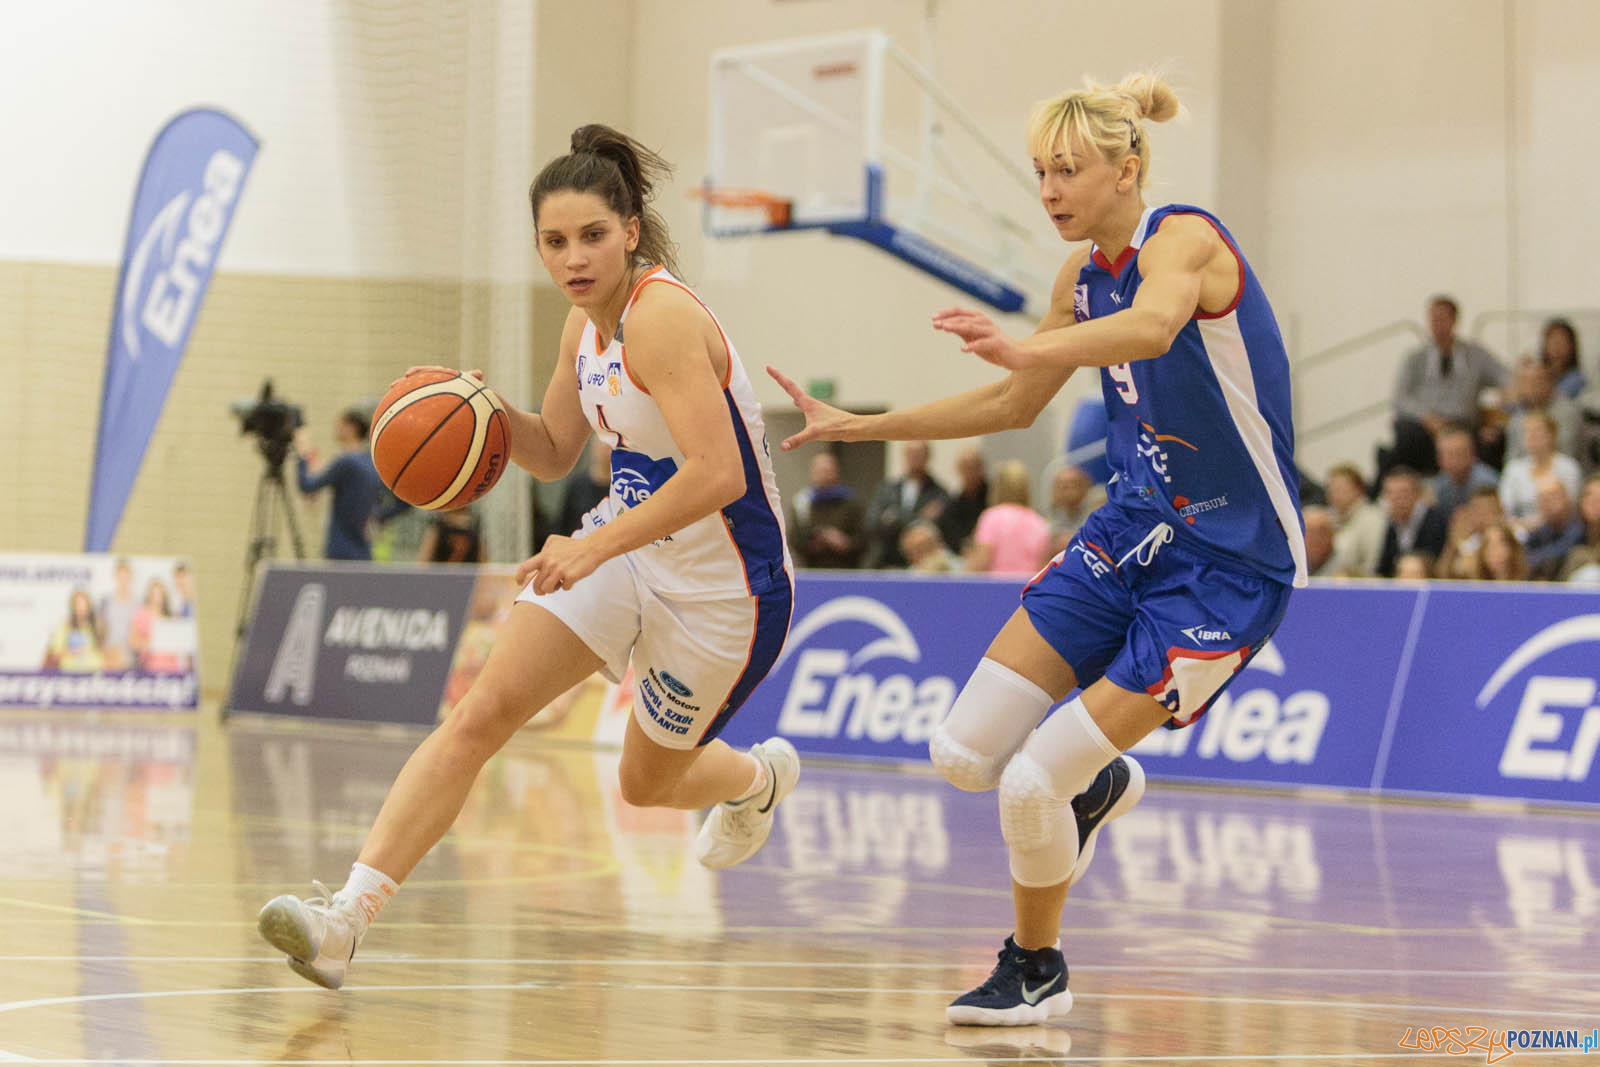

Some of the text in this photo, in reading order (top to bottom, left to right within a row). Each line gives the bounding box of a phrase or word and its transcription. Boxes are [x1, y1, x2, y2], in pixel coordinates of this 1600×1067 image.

[143, 150, 243, 347] Enea
[1108, 362, 1139, 405] 9
[613, 477, 652, 502] Ene
[1179, 495, 1229, 517] CENTRUM
[324, 605, 449, 652] AVENIDA
[666, 692, 700, 711] Motors
[777, 648, 957, 744] Enea
[664, 708, 693, 725] SZKÓŁ
